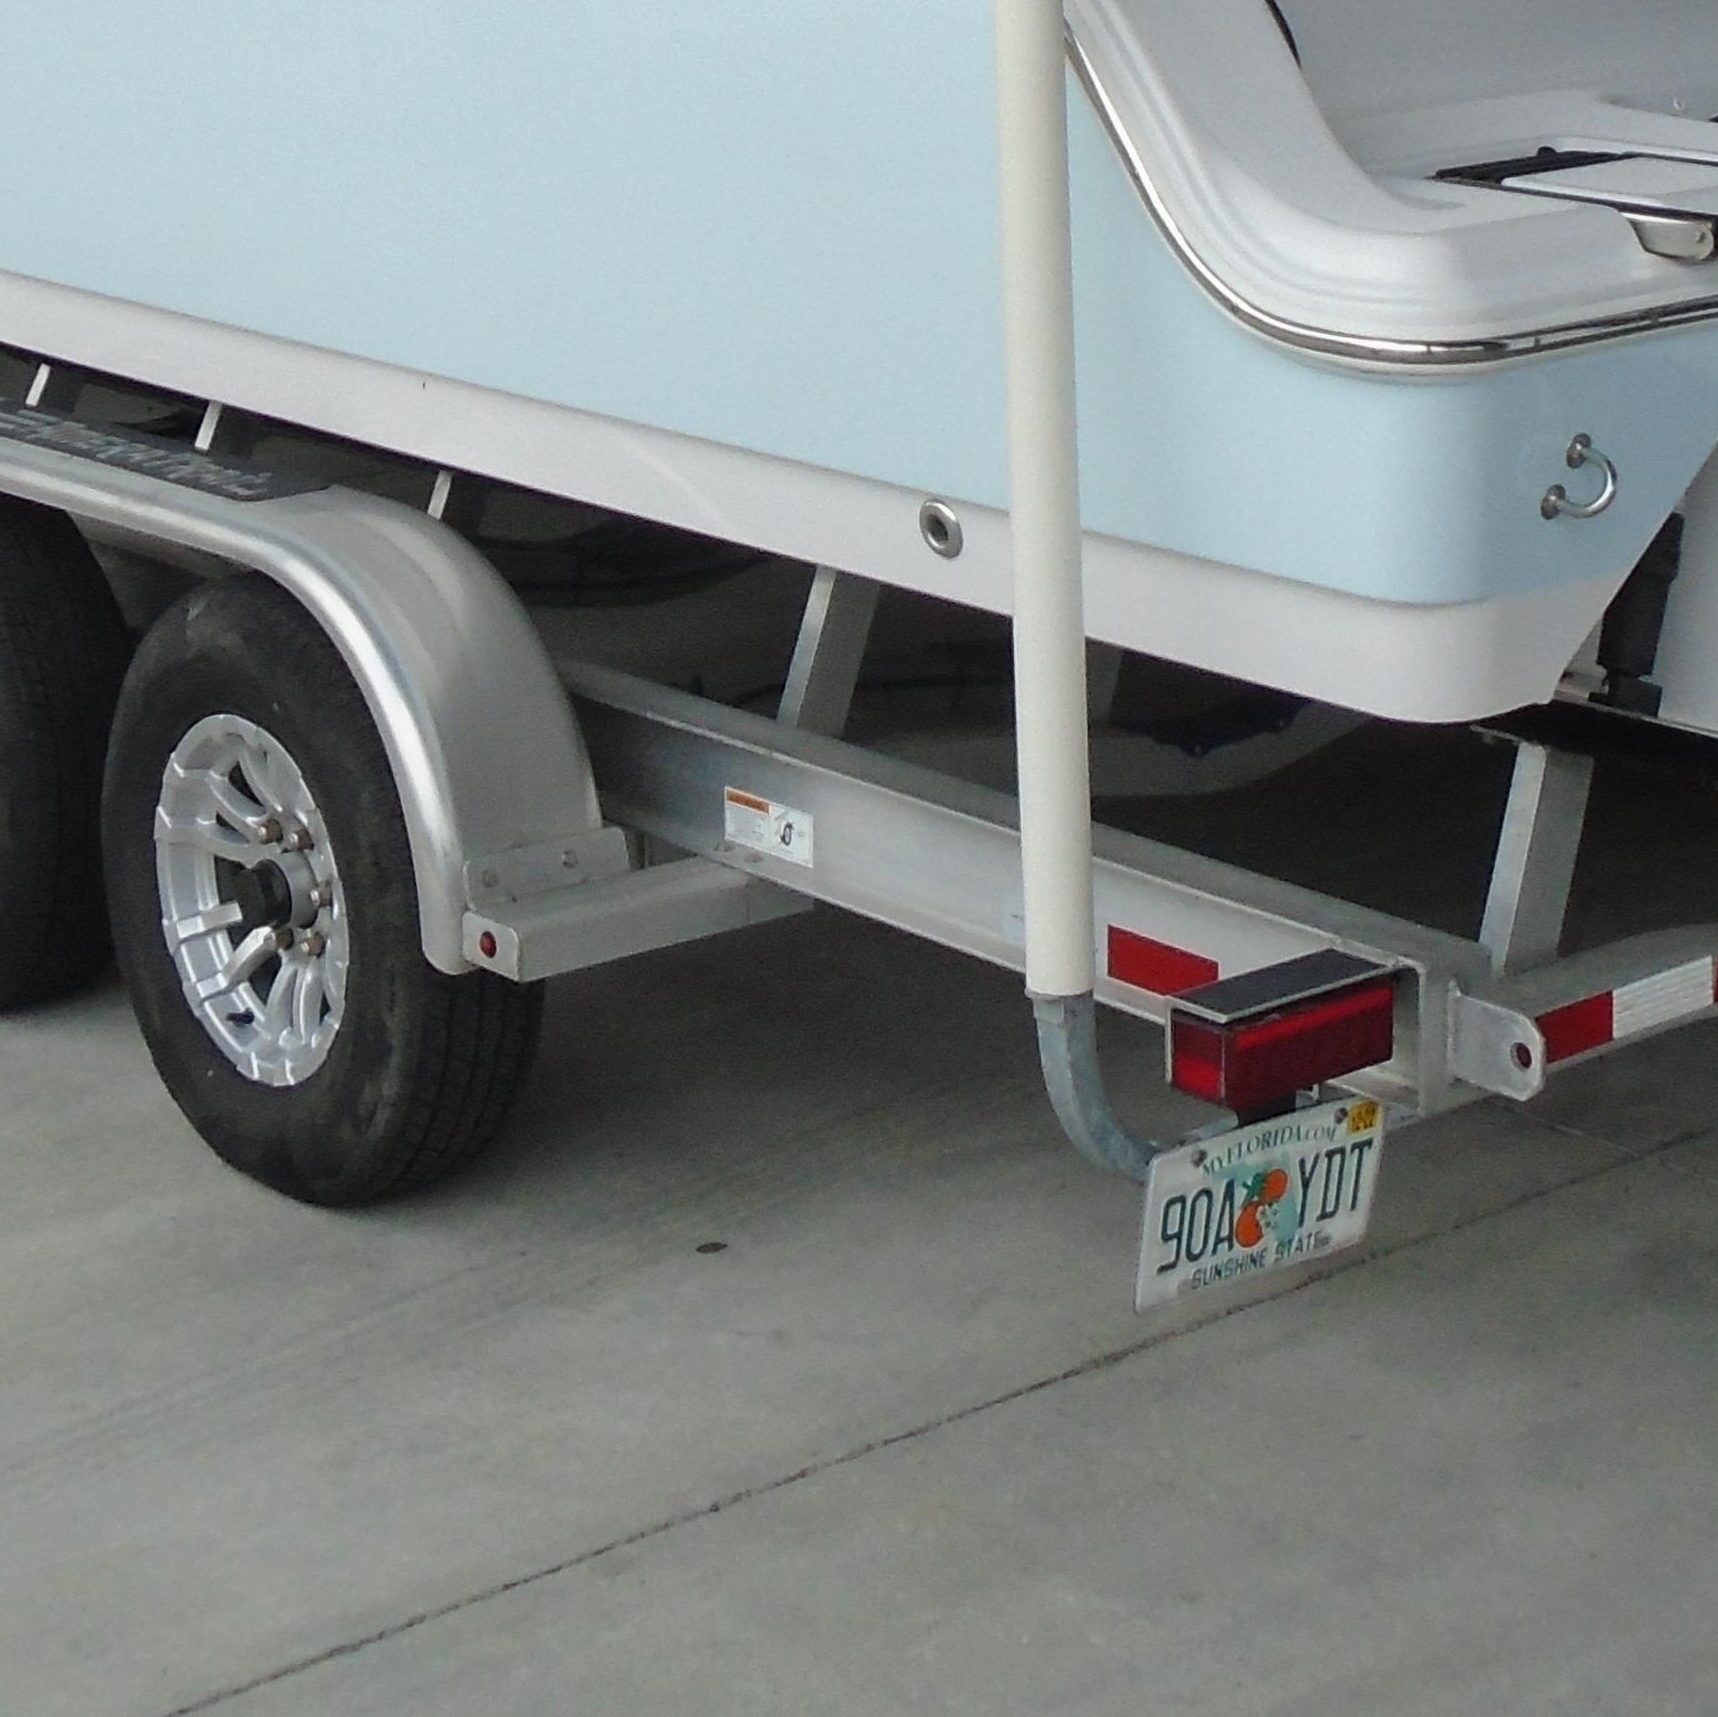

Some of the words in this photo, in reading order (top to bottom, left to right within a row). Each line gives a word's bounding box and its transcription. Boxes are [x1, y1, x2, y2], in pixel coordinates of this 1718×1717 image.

[1298, 1137, 1374, 1228] YDT
[1191, 1248, 1268, 1290] SUNSHINE
[1275, 1229, 1327, 1260] STATE
